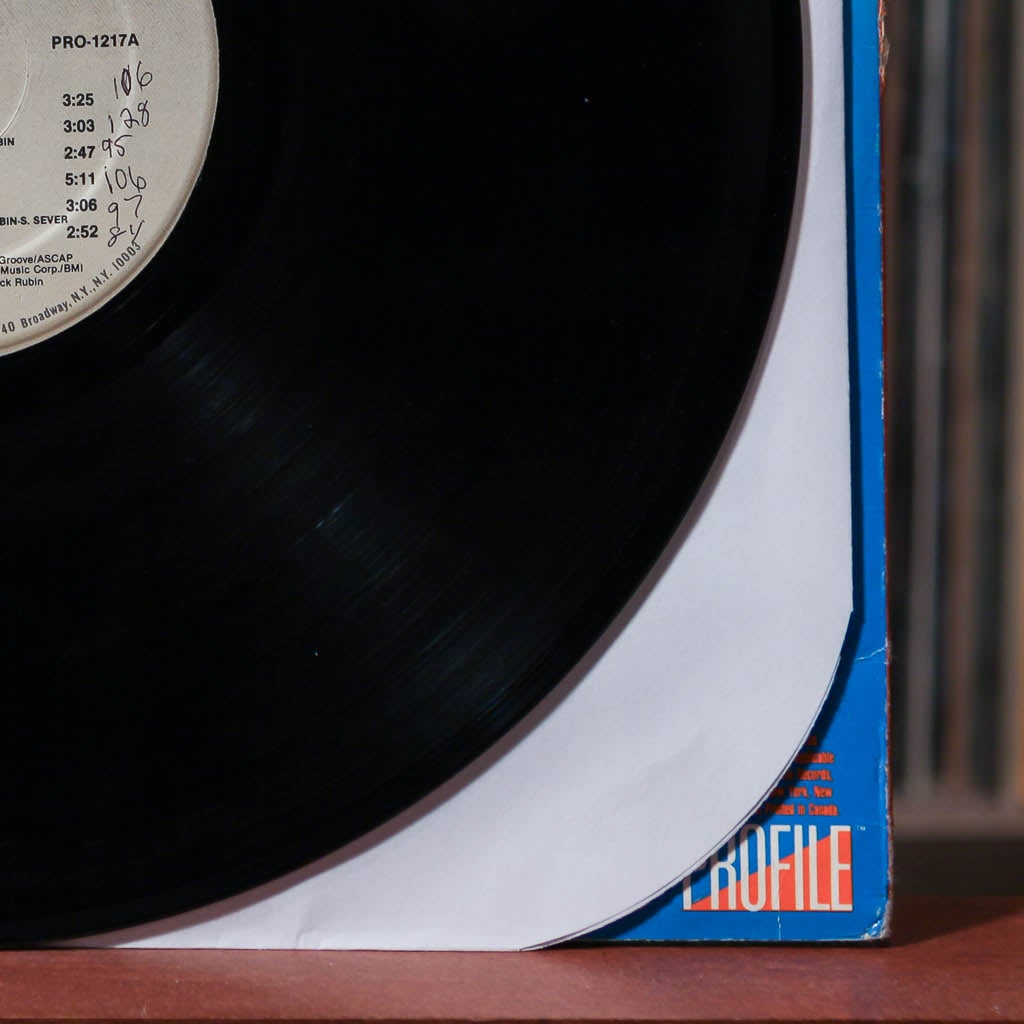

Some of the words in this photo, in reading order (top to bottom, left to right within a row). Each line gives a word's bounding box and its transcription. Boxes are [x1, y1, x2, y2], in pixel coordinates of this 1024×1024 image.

[52, 34, 139, 49] PRO-1217A
[62, 94, 94, 106] 3:25
[108, 100, 149, 133] 128
[64, 120, 95, 132] 3:03
[64, 146, 95, 159] 2:47
[102, 134, 132, 158] 95
[65, 173, 96, 186] 5:11
[66, 199, 97, 212] 3:06
[108, 195, 142, 226] 97
[34, 215, 68, 224] SEVER
[66, 226, 98, 238] 2:52
[0, 265, 30, 274] Music
[33, 264, 83, 275] Corp./BMI
[15, 278, 44, 286] Rubin
[20, 301, 72, 329] Broadway,
